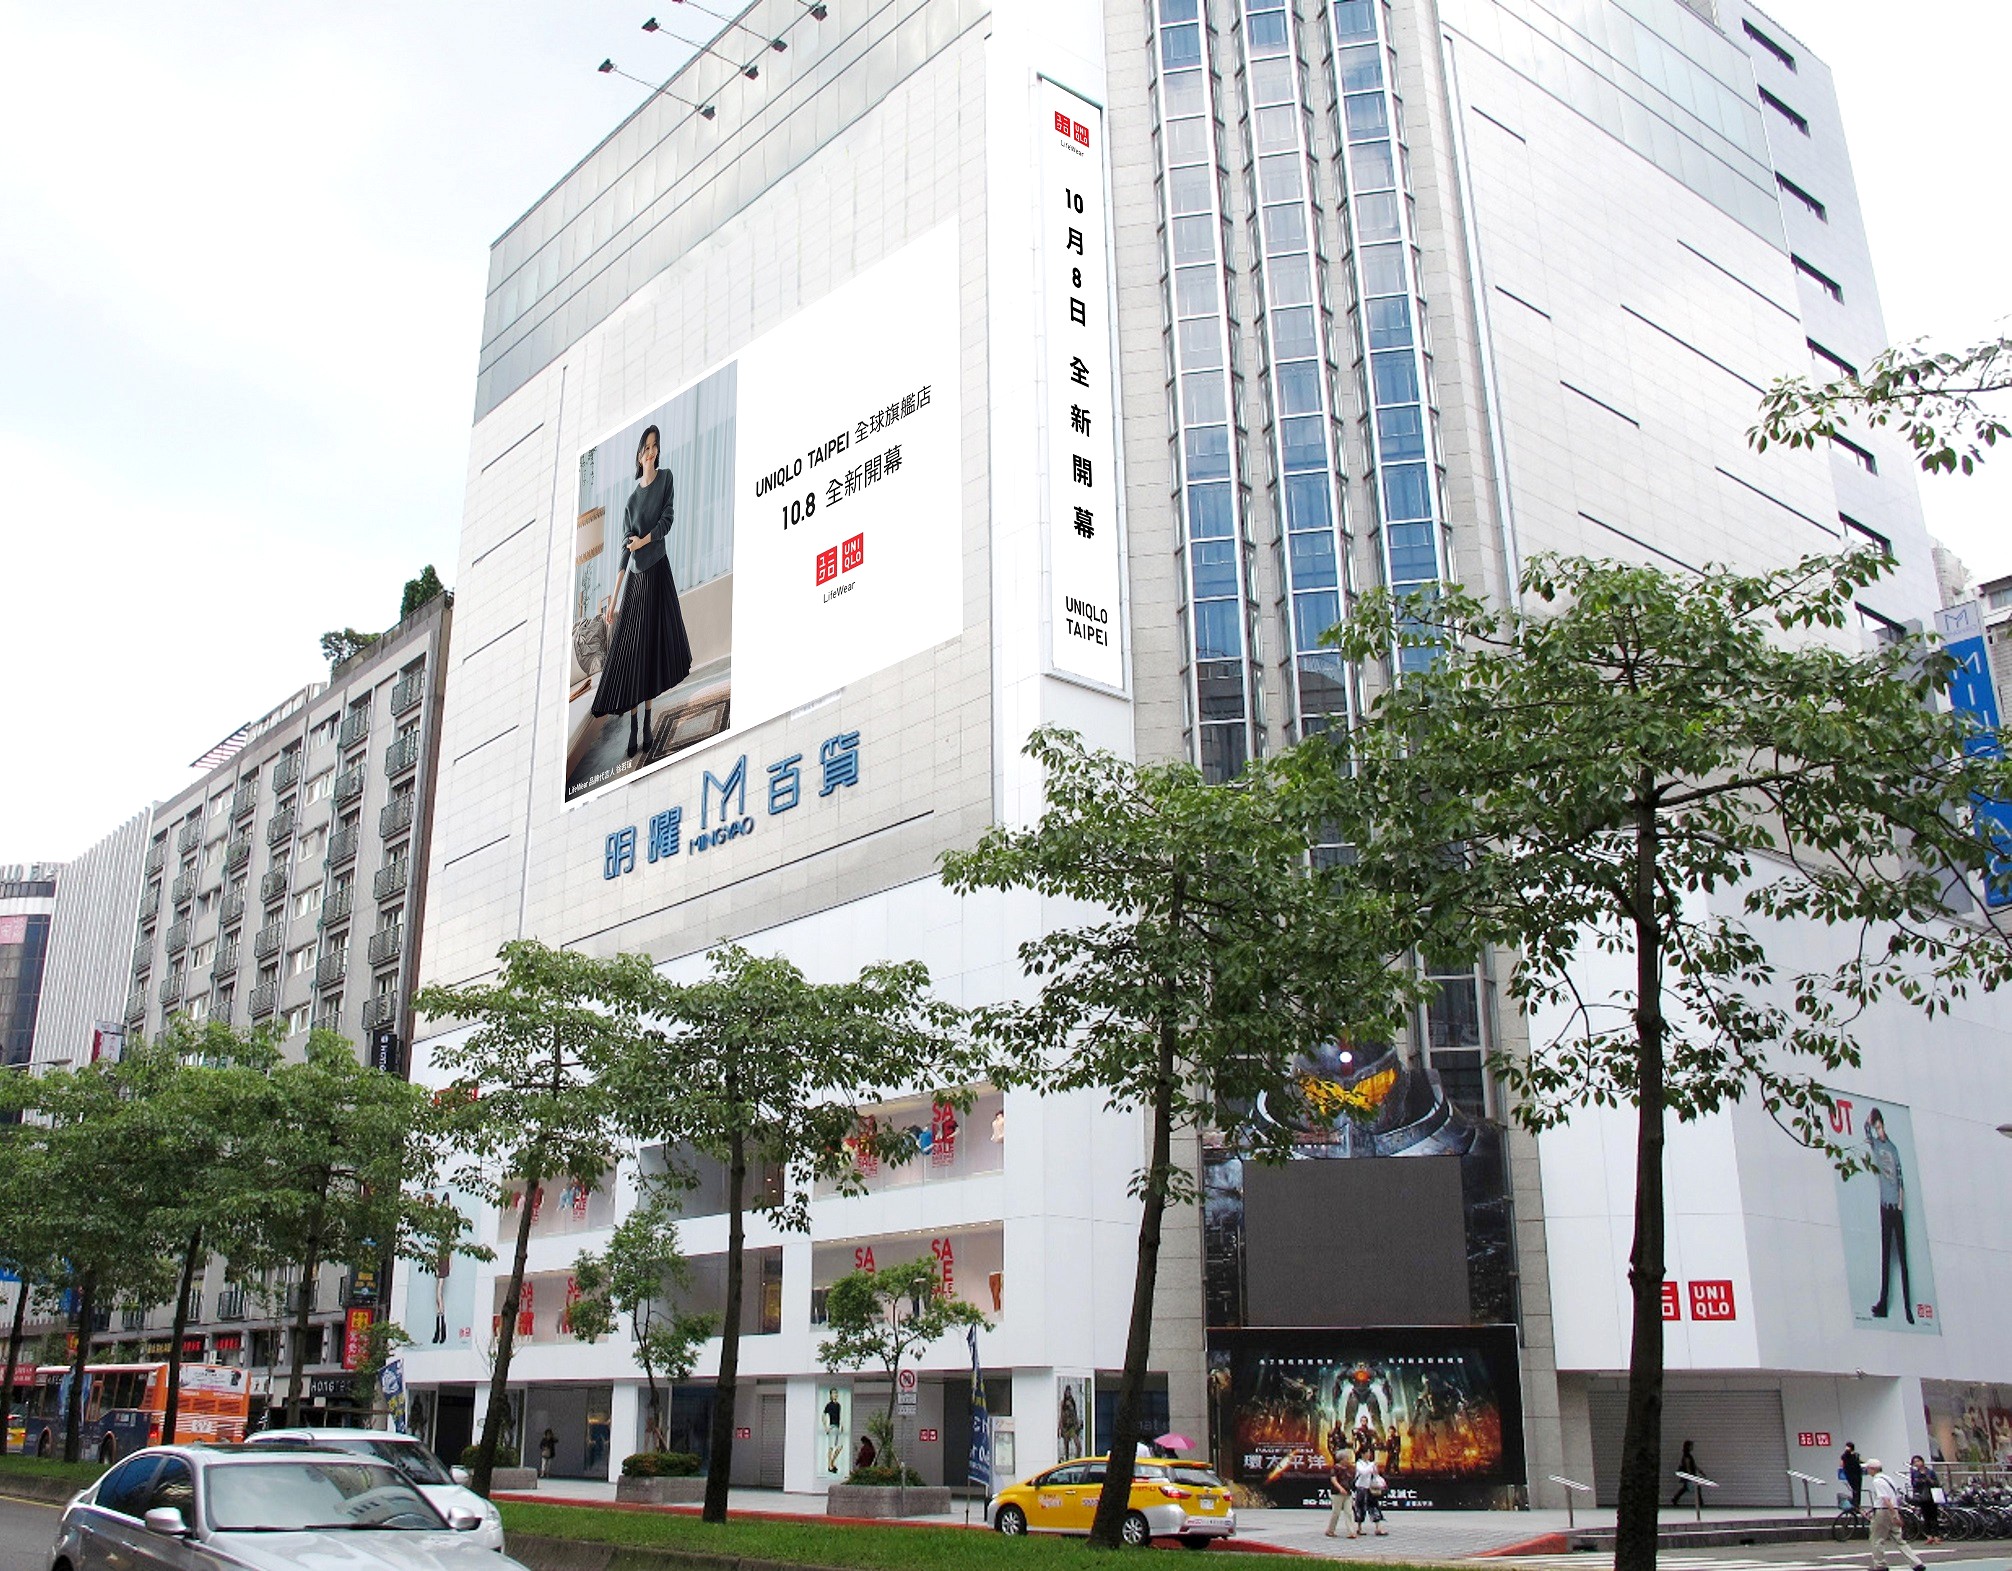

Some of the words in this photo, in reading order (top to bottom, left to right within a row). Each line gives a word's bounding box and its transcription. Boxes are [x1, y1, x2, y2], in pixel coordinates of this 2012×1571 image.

[1060, 140, 1085, 157] LifeWear
[755, 457, 802, 498] UNIQLO
[807, 430, 850, 469] TAIPEI
[854, 384, 932, 444] 全球旗艦店
[1069, 355, 1095, 539] 全新開幕
[782, 491, 816, 531] 10.8
[825, 443, 903, 508] 全新開幕
[823, 581, 856, 604] LifeWear
[1065, 595, 1108, 624] UNIQLO
[1065, 617, 1108, 647] TAIPEI
[603, 805, 682, 880] 明曜
[766, 729, 861, 816] 百貨
[689, 816, 755, 856] MINGYAO
[1693, 1285, 1726, 1301] UNI
[1695, 1301, 1731, 1319] QLO
